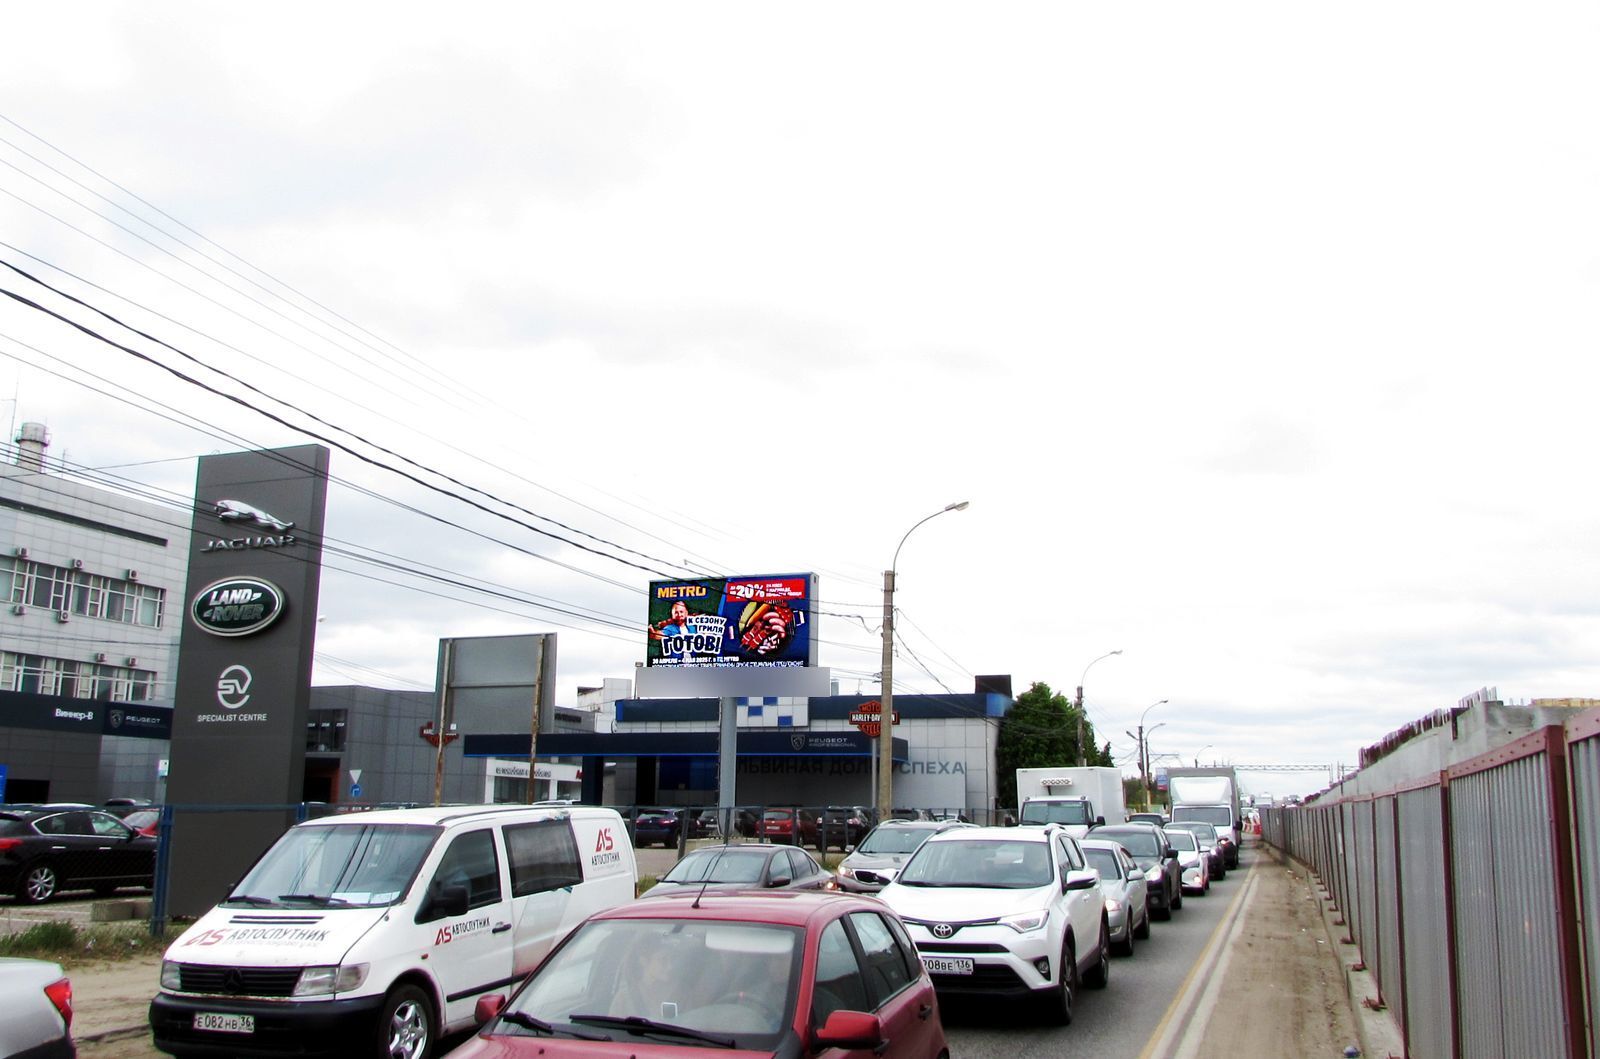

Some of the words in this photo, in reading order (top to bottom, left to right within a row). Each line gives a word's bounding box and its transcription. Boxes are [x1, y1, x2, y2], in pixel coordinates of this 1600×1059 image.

[200, 535, 295, 552] JAGUAR
[209, 588, 253, 606] LAND
[657, 585, 707, 599] METRO
[211, 604, 264, 622] ROVER
[695, 617, 725, 625] СЕЗОНУ
[698, 625, 724, 633] ГРИЛЯ
[662, 634, 722, 655] ГОТОВ!
[125, 715, 161, 723] PEUGEOT
[197, 714, 237, 723] SPECIALIST
[238, 713, 268, 722] CENTRE
[595, 827, 614, 853] AS
[181, 928, 231, 947] AS
[227, 928, 330, 942] АВТОСПУТНИК
[434, 926, 452, 946] AS
[452, 917, 491, 935] АВТОСПУТНИК
